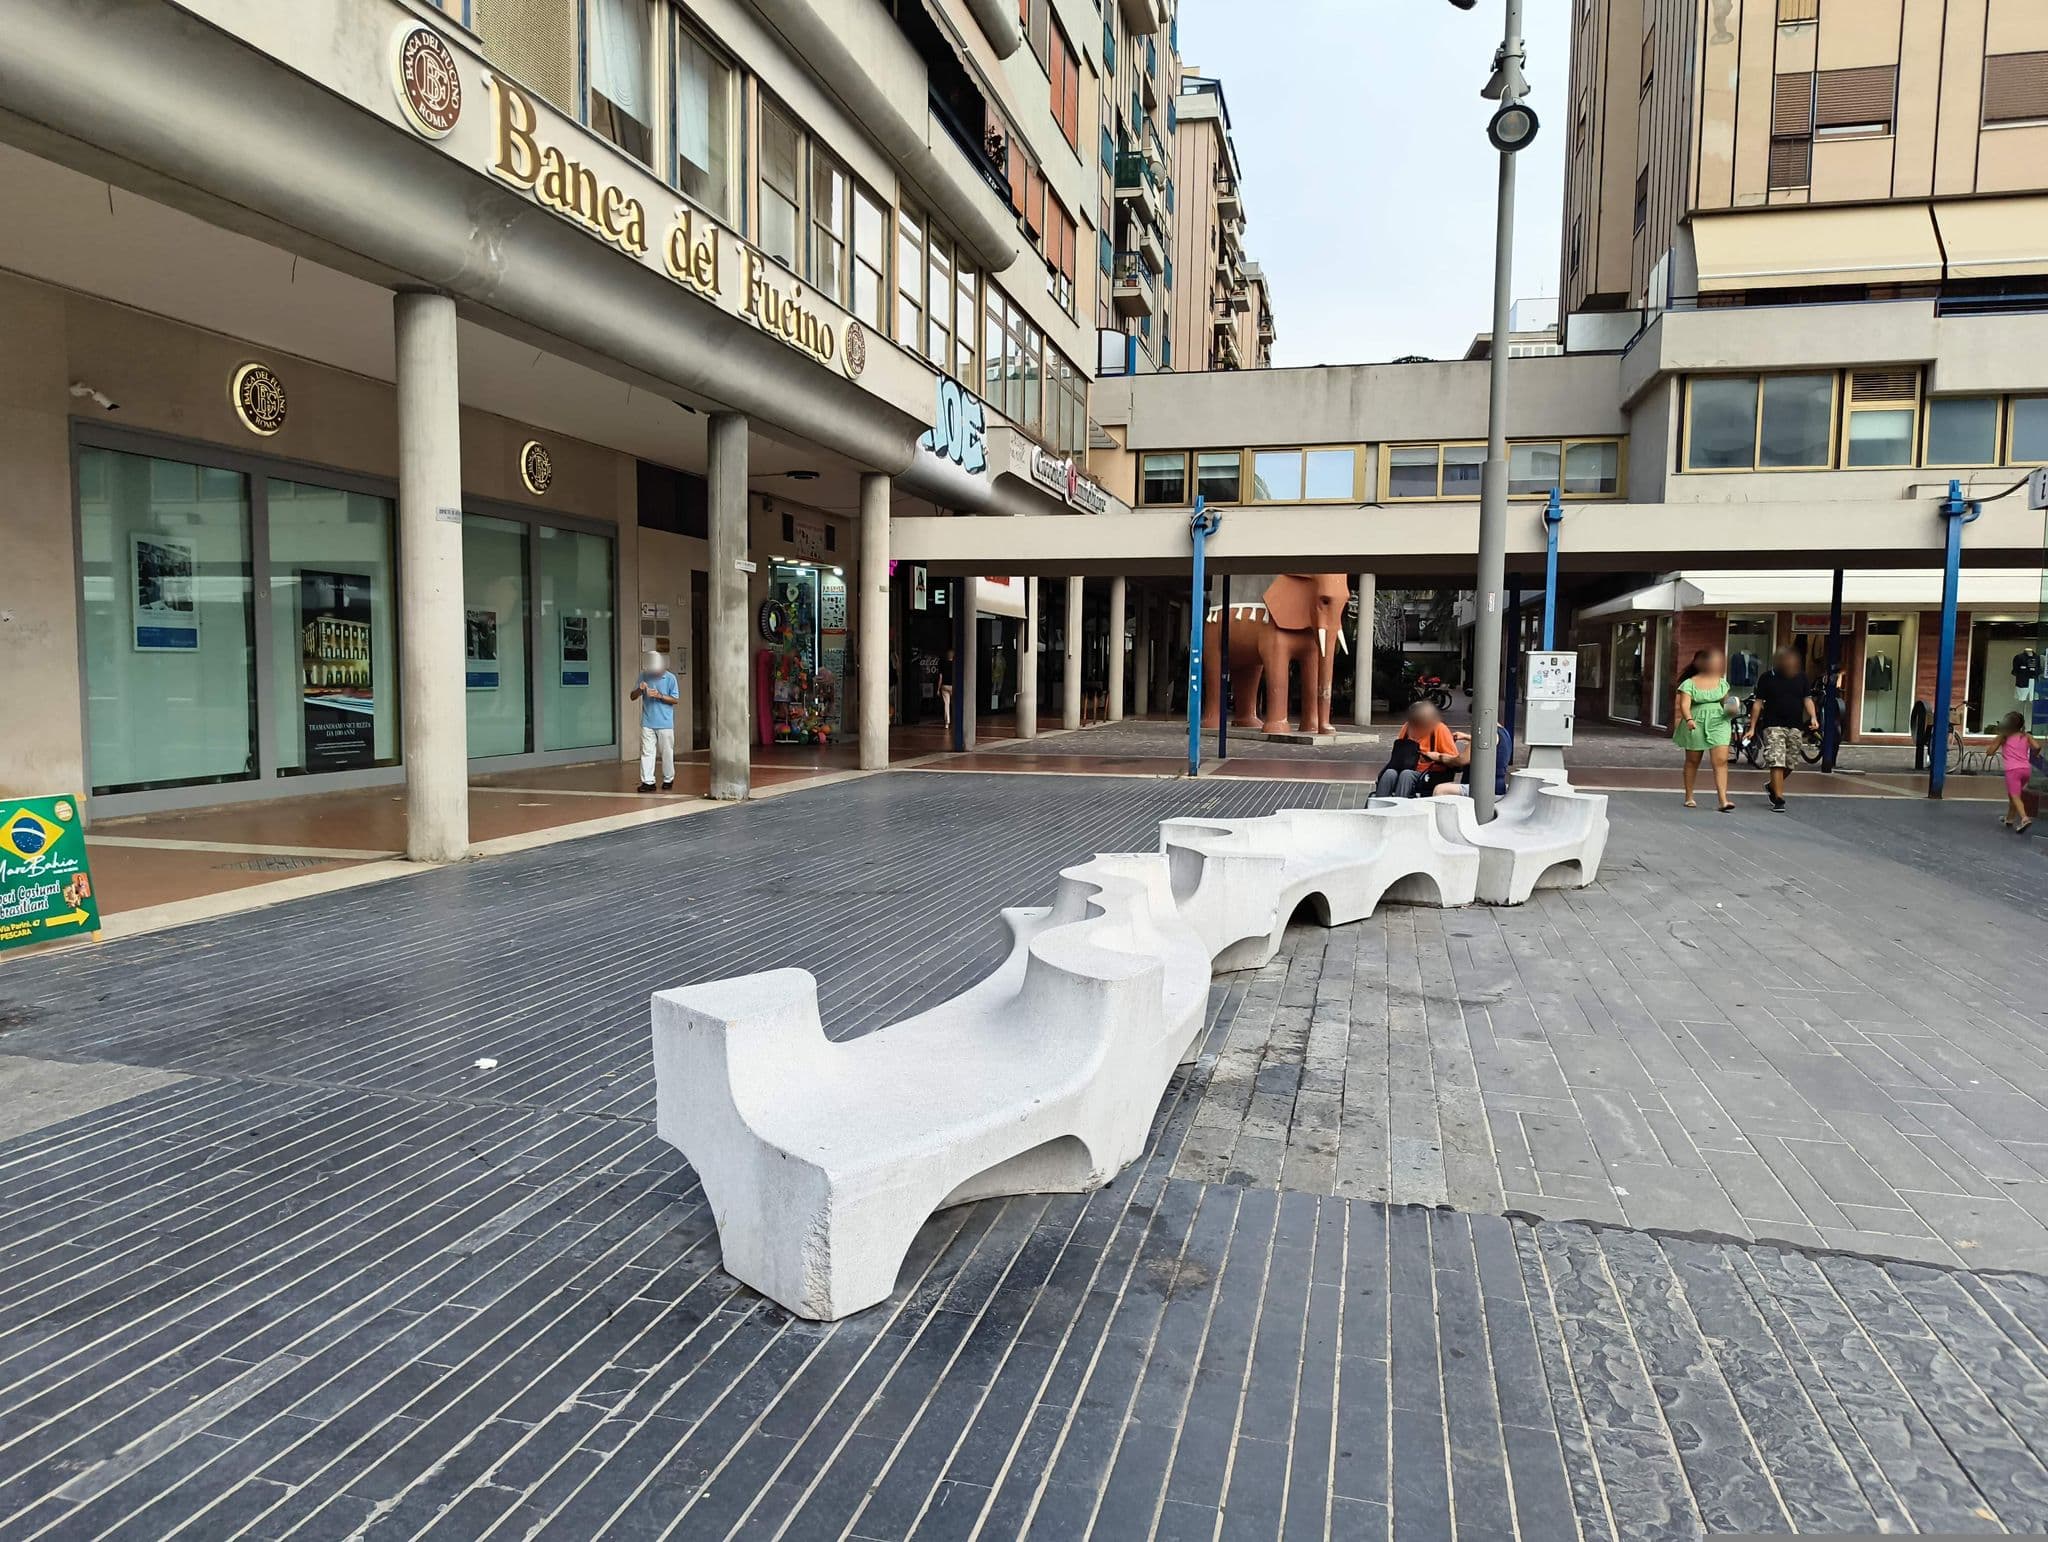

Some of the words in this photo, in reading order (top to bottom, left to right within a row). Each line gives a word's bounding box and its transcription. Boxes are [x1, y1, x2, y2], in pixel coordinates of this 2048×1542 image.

[405, 35, 422, 80] BANCA
[421, 32, 440, 53] DEL
[440, 49, 459, 109] FUCINO
[419, 101, 448, 128] ROMA
[485, 71, 649, 256] Banca
[666, 206, 723, 299] del
[740, 243, 835, 363] Fucino
[255, 371, 270, 381] DEL
[17, 880, 61, 901] Costumi
[0, 896, 49, 919] brasiliani
[0, 928, 32, 941] PESCARA
